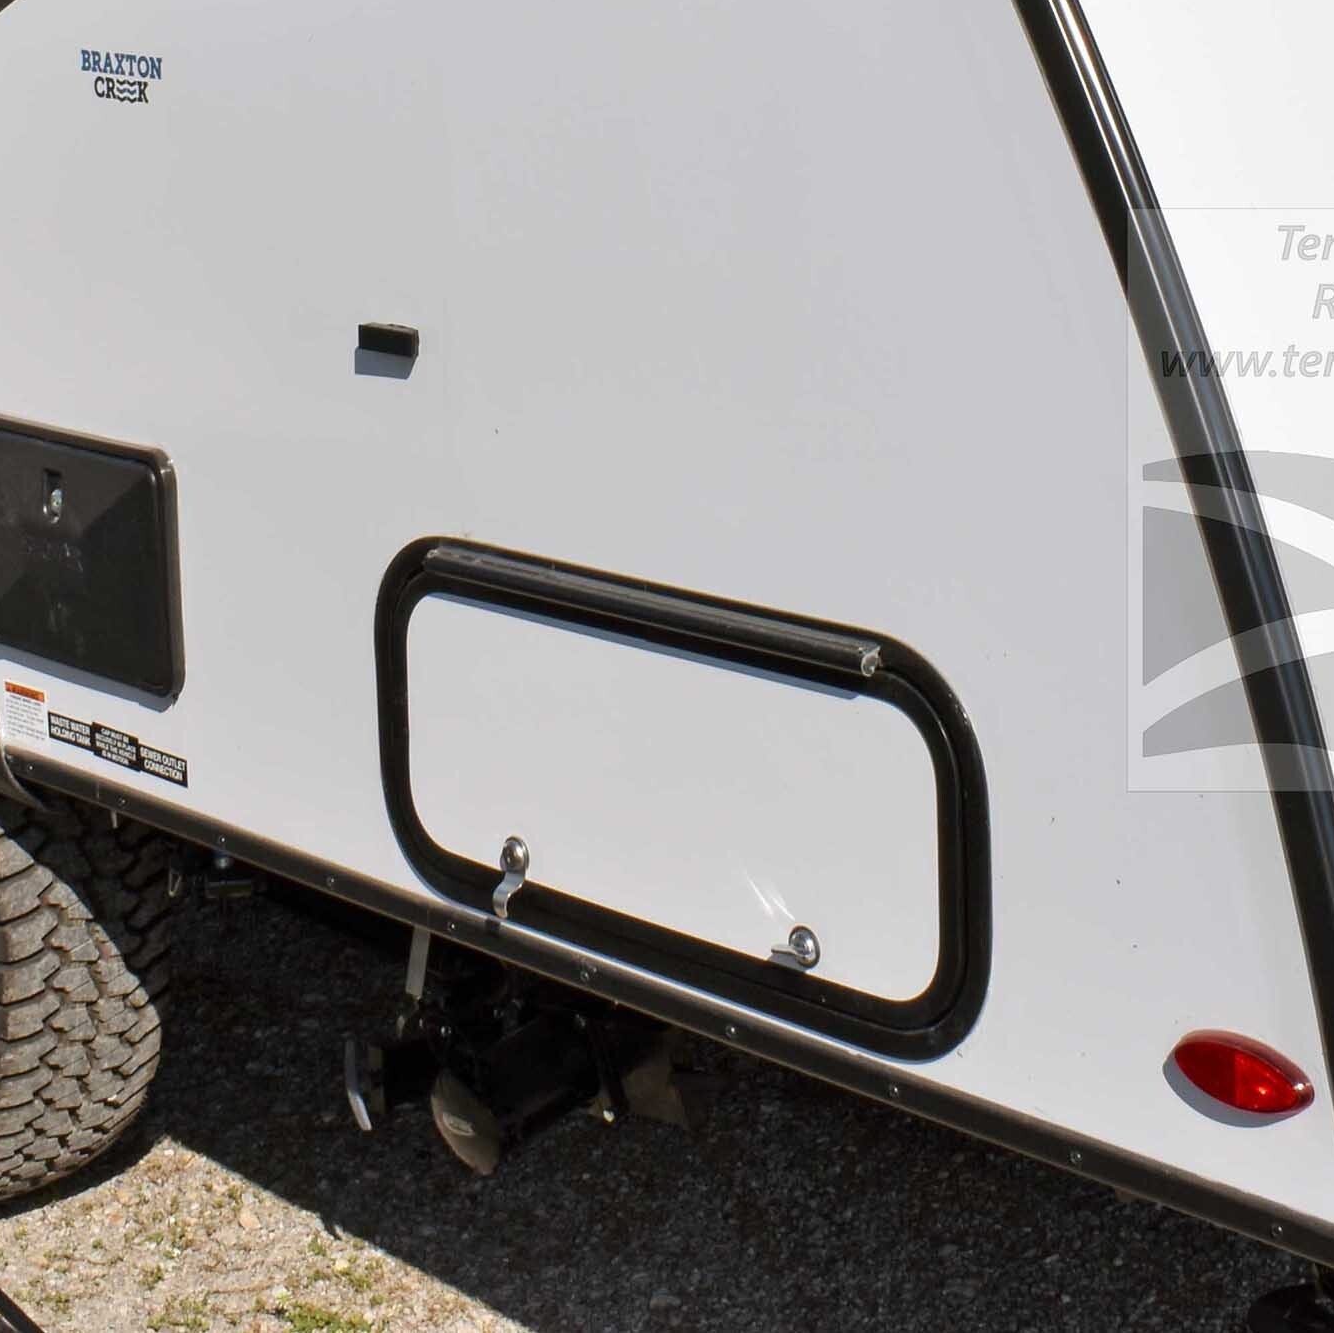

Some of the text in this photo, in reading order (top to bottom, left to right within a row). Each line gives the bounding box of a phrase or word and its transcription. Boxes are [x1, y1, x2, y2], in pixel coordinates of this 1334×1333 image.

[80, 49, 163, 80] BRAXTON
[140, 746, 186, 771] SEWER OUTLET
[144, 759, 183, 781] CONNECTION
